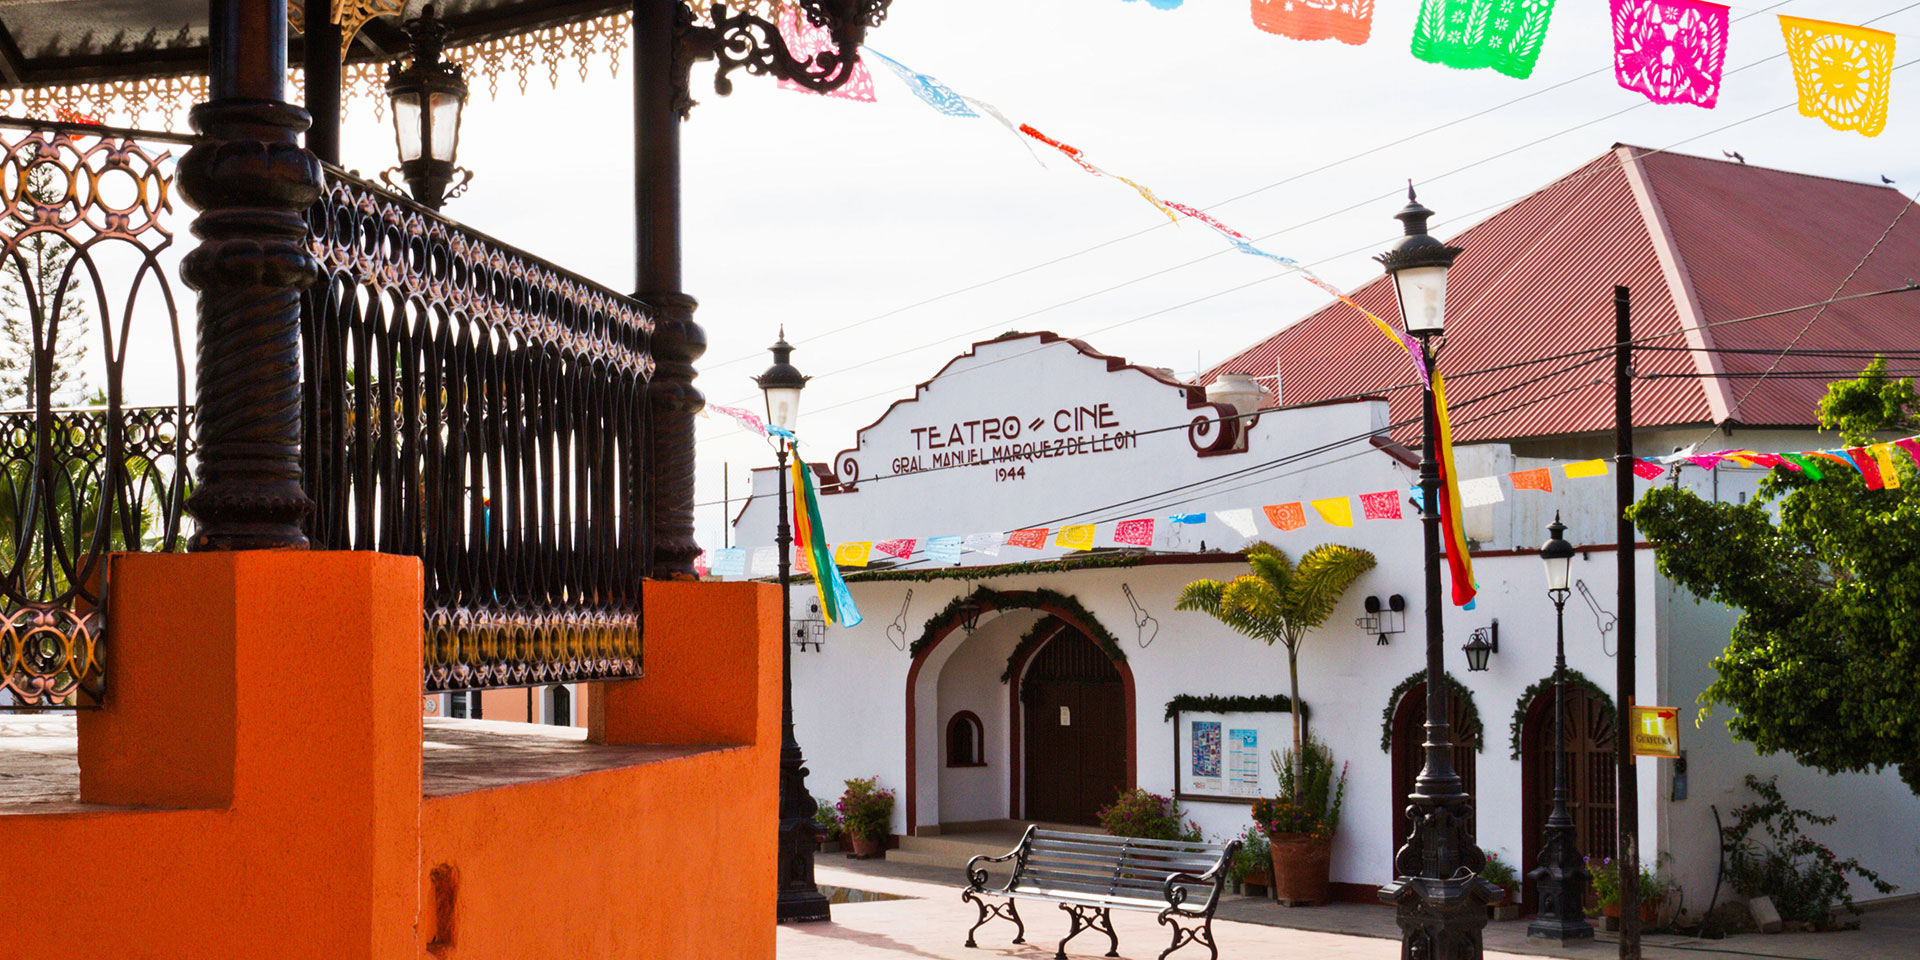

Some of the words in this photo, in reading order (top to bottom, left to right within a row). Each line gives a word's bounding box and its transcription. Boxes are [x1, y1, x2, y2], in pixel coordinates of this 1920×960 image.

[911, 416, 1021, 450] TEATRO
[1053, 403, 1119, 433] CINE
[933, 448, 989, 469] MANUEL
[992, 439, 1065, 463] MARQUEZ
[1067, 436, 1088, 456] DE
[1092, 429, 1136, 453] LEON
[995, 466, 1026, 482] 1944
